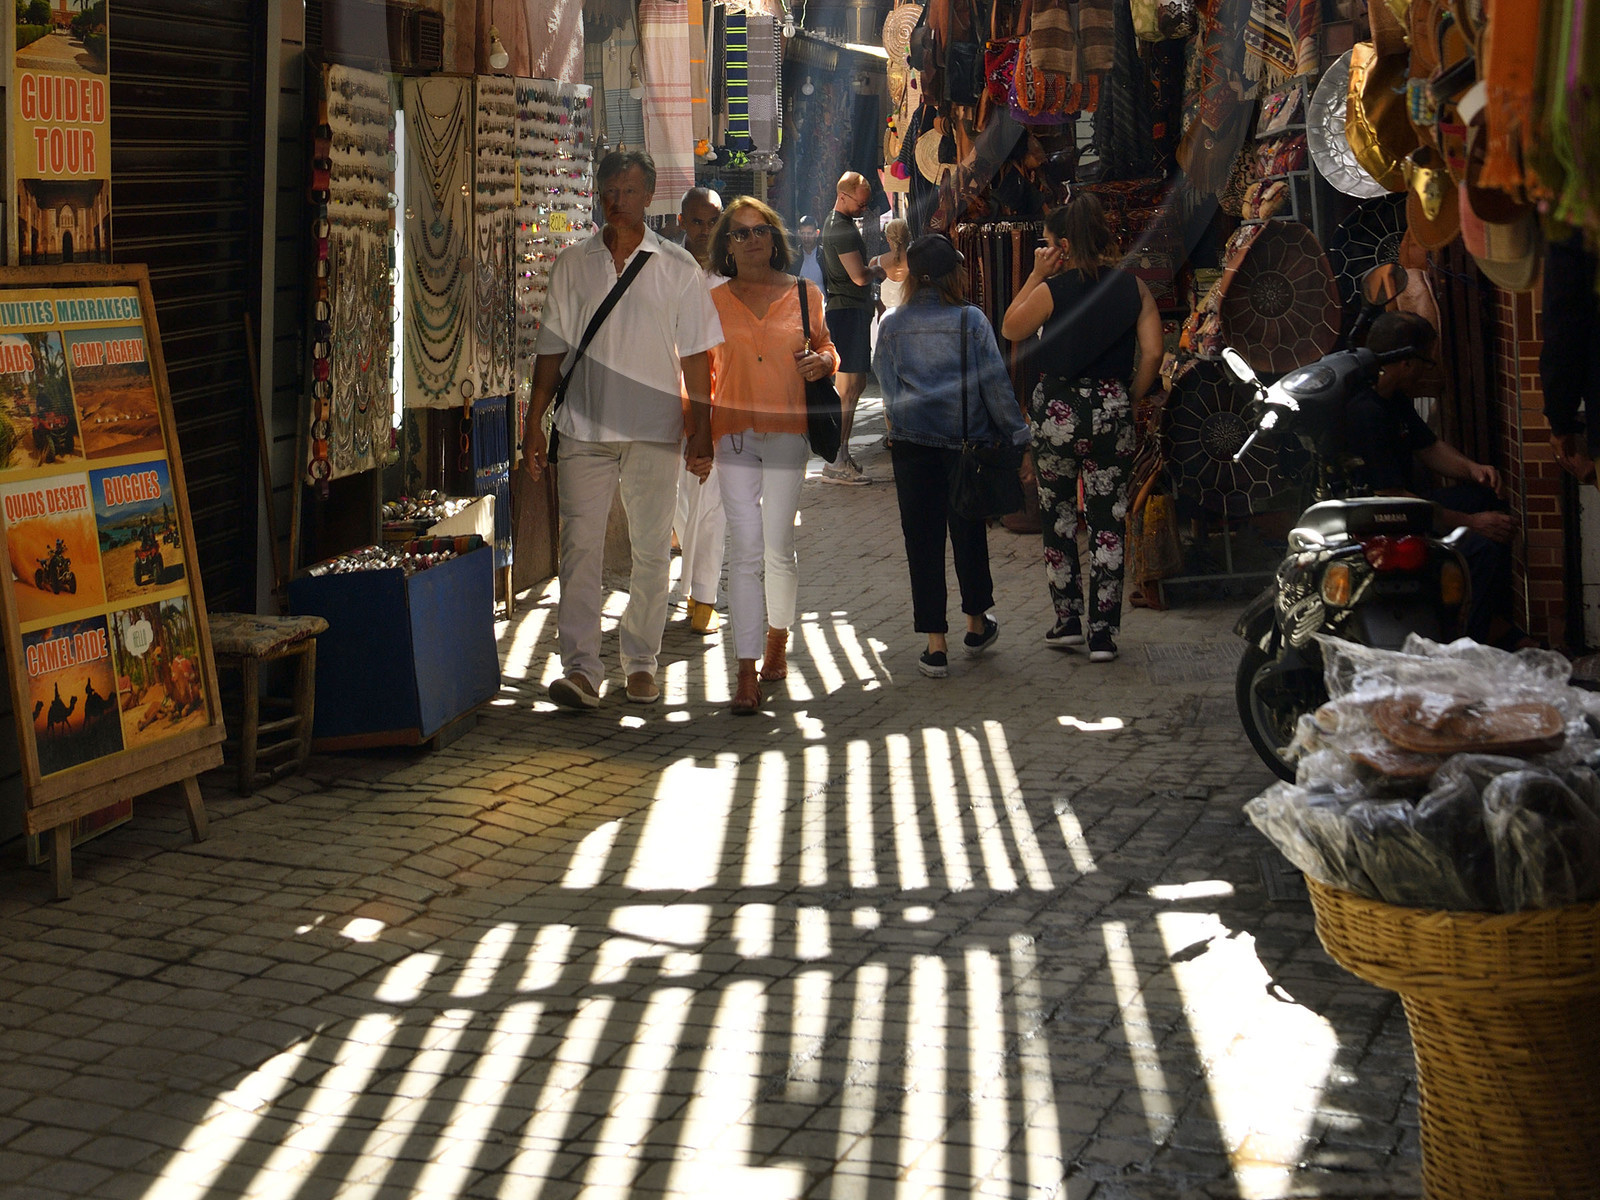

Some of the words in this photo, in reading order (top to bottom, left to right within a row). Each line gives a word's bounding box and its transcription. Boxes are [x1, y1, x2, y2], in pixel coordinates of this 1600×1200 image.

[21, 73, 106, 123] GUIDED
[34, 127, 96, 174] TOUR
[56, 297, 141, 323] MARRAKECH
[72, 341, 104, 367] CAMP
[105, 338, 144, 365] AGAFAY
[5, 490, 46, 522] QUADS
[46, 484, 88, 513] DESERT
[102, 470, 161, 507] BUGGIES
[1373, 512, 1408, 523] YAMAHA
[27, 637, 74, 677] CAMEL
[74, 628, 108, 664] RIDE
